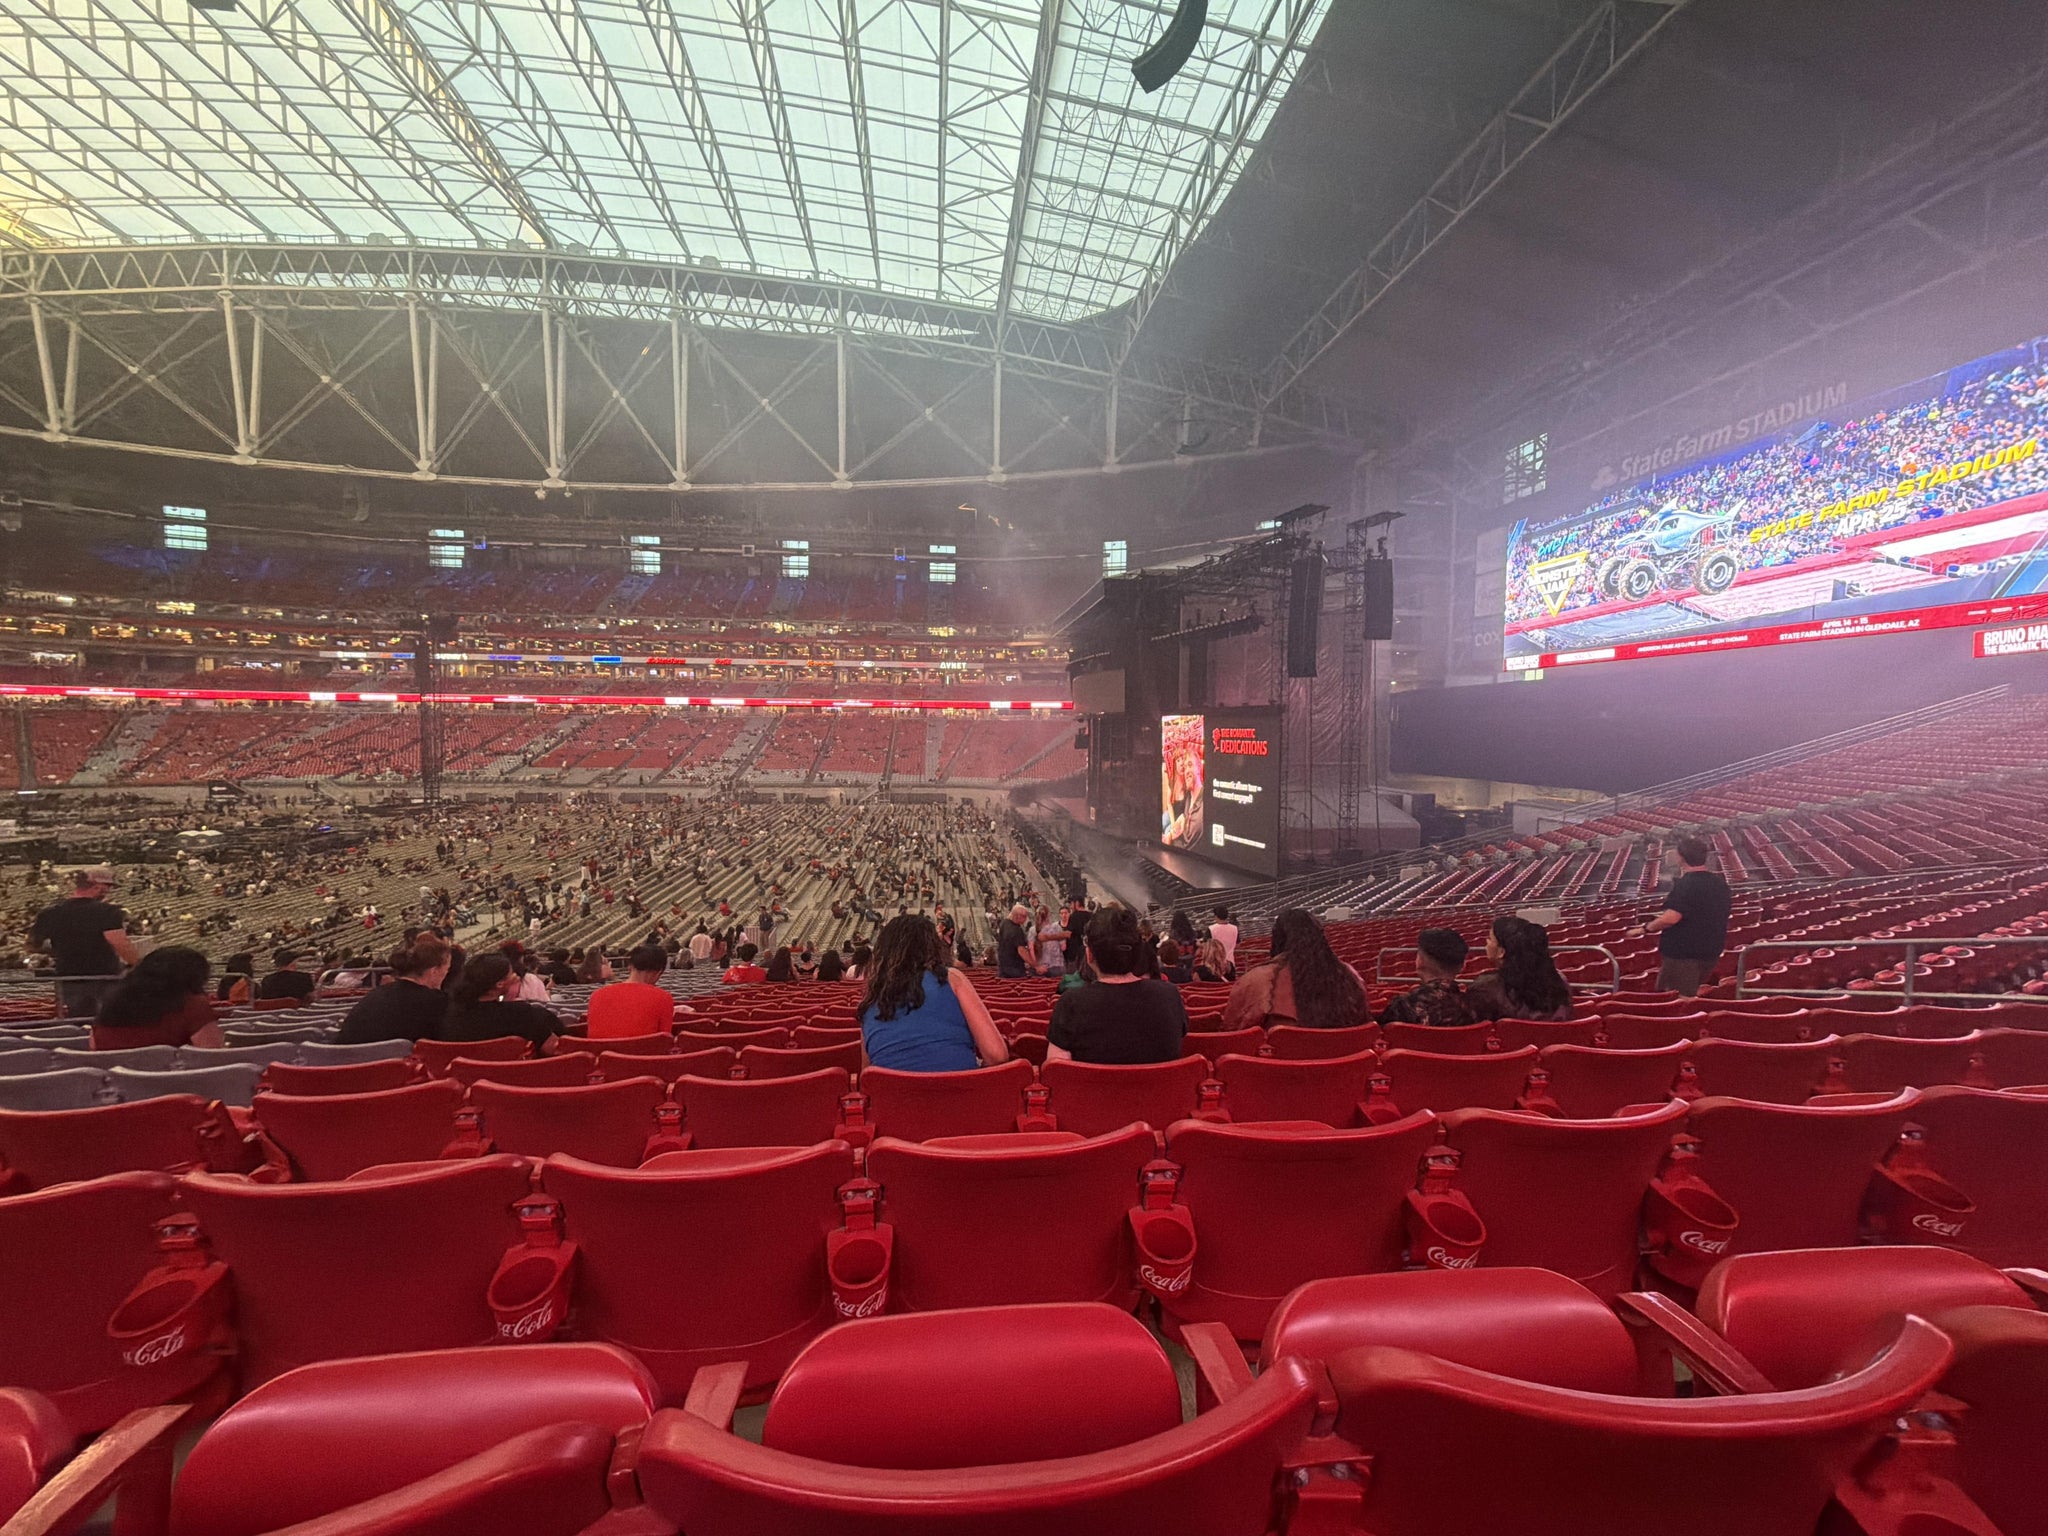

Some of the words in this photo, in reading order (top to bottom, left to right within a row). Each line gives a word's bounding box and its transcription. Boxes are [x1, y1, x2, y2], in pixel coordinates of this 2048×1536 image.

[1735, 382, 1847, 440] STADIUM
[1749, 510, 1814, 544] STATE
[1819, 487, 1888, 521] FARM
[1895, 438, 2039, 499] STADIUM
[1835, 513, 1877, 536] APR
[1879, 502, 1908, 525] 25
[1527, 562, 1586, 586] MONSTER
[1543, 577, 1571, 594] JAM
[1780, 632, 1801, 641] STATE
[1800, 630, 1821, 639] FARM
[1821, 627, 1855, 636] STADIUM
[1907, 618, 1921, 628] AZ
[1822, 620, 1843, 629] APRIL
[1984, 628, 2026, 645] BRUNO
[1984, 644, 1998, 656] THE
[1998, 640, 2040, 654] ROMANTIC
[1221, 740, 1268, 756] DEDICATIONS
